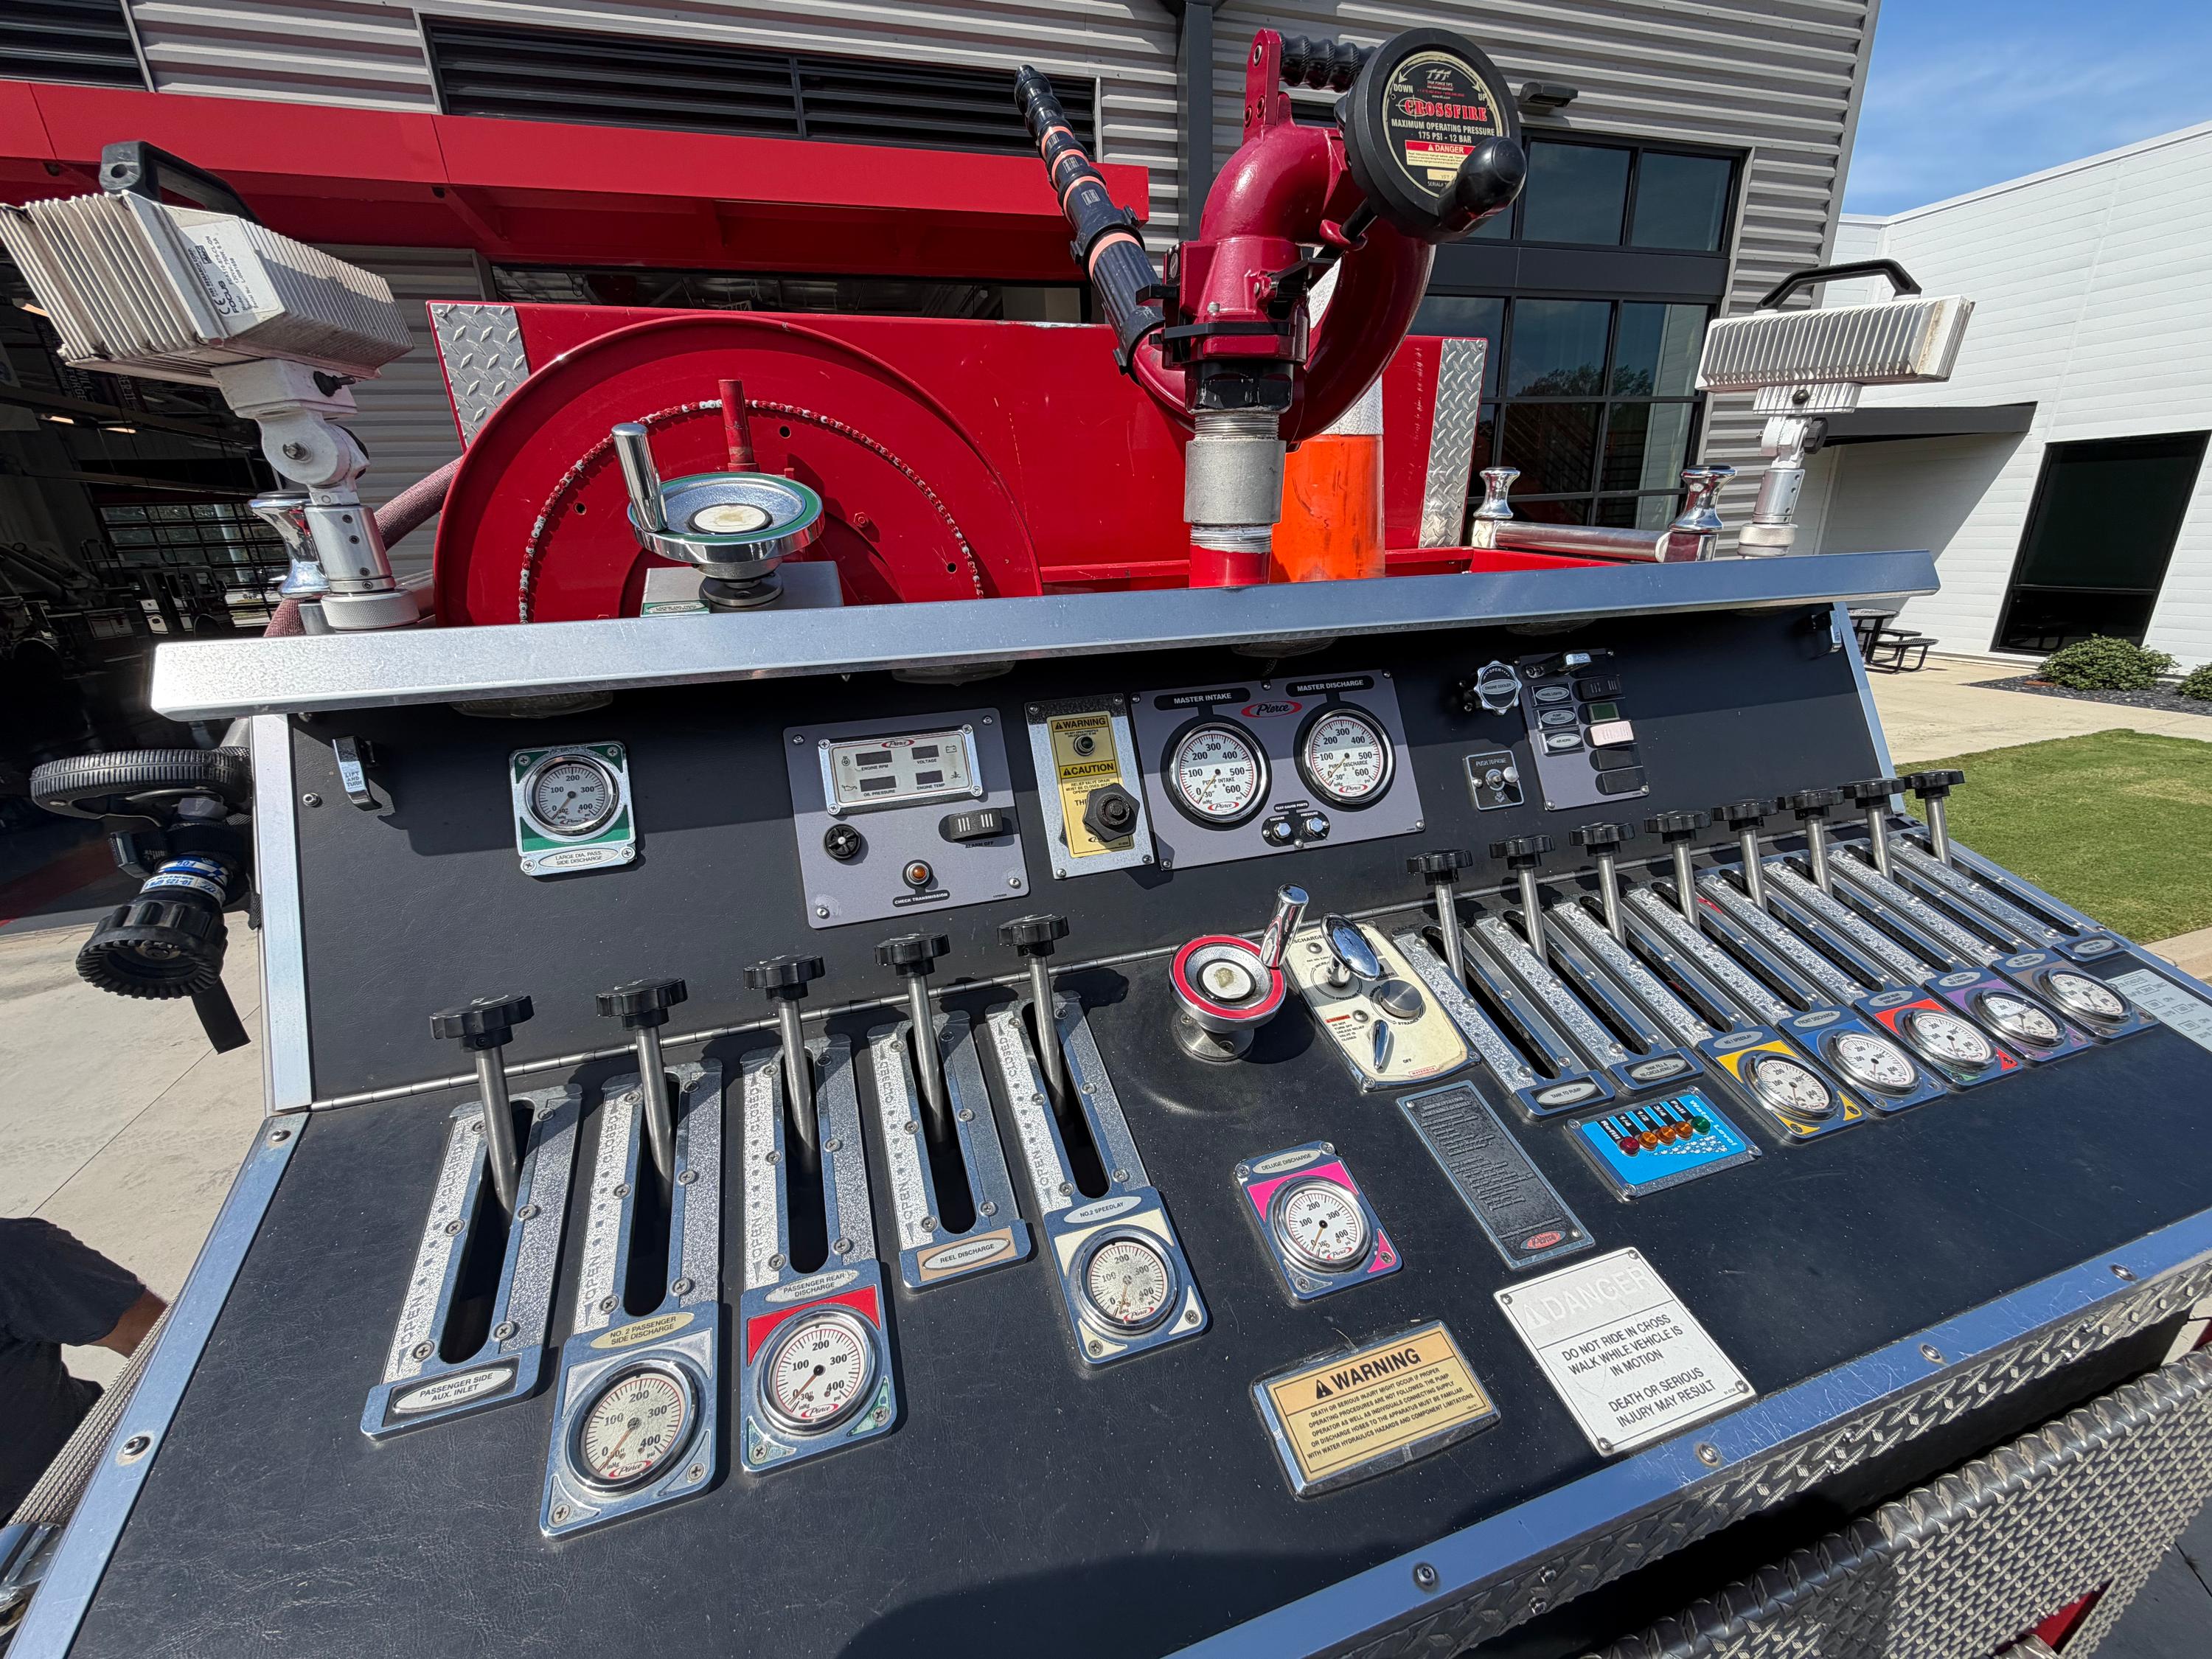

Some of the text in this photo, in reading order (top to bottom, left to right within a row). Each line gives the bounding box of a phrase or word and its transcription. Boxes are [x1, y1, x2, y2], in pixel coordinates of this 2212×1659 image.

[1394, 83, 1413, 93] DOWN
[1478, 93, 1486, 101] UP
[1405, 100, 1487, 122] CROSSFIRE
[1391, 119, 1495, 136] MAXIMUM OPERATING PRESSURE
[1418, 131, 1430, 140] 175
[1432, 133, 1442, 141] PSI
[1459, 135, 1472, 143] BAR
[1436, 145, 1464, 153] DANGER
[218, 281, 240, 313] FOCUS
[1297, 680, 1364, 692] MASTER DISCHARGE
[1174, 693, 1232, 704] MASTER INTAKE
[1256, 703, 1290, 716] Pierce
[1062, 717, 1106, 728] WARNING
[1335, 728, 1350, 736] 300
[1206, 742, 1222, 751] 300
[1323, 737, 1338, 745] 200
[1351, 736, 1366, 744] 400
[1192, 751, 1208, 761] 200
[1222, 751, 1237, 759] 400
[1320, 753, 1333, 761] 100
[1358, 751, 1372, 759] 500
[1071, 762, 1114, 774] CAUTION
[1343, 759, 1368, 768] DISCHARGE
[1188, 769, 1203, 778] 100
[1229, 767, 1245, 776] 500
[1354, 768, 1369, 776] 600
[1225, 785, 1241, 794] 600
[571, 855, 602, 863] DISCHARGE
[894, 892, 948, 905] CHECK TRANSMISSION
[1000, 1037, 1017, 1077] CLOSED
[1653, 1105, 1667, 1116] 3/4
[1670, 1100, 1687, 1114] Full
[1619, 1116, 1632, 1127] 1/4
[1637, 1110, 1649, 1121] 1/2
[1689, 1099, 1738, 1146] Water Level
[1600, 1120, 1621, 1140] Refill
[1034, 1150, 1049, 1186] OPEN
[1261, 1152, 1312, 1171] DELUGE DISCHARGE
[1079, 1201, 1124, 1218] NO.2 SPEEDLAY
[959, 1244, 995, 1258] DISCHARGE
[783, 1273, 845, 1293] PASSENGER REAR
[795, 1282, 835, 1297] DISCHARGE
[1543, 1266, 1655, 1321] DANGER
[632, 1316, 676, 1332] PASSENGER
[611, 1324, 674, 1345] SIDE DISCHARGE
[1562, 1314, 1671, 1361] DO NOT RIDE IN CROSS
[813, 1340, 830, 1351] 200
[1568, 1325, 1683, 1375] WALK WHILE VEHICLE IS
[792, 1360, 809, 1371] 100
[830, 1354, 848, 1365] 300
[1610, 1349, 1664, 1377] IN MOTION
[1329, 1347, 1422, 1391] WARNING
[420, 1373, 493, 1398] PASSENGER SIDE
[827, 1380, 844, 1391] 400
[1608, 1367, 1704, 1413] DEATH OR SERIOUS
[431, 1383, 479, 1402] AUX. INLET
[1311, 1408, 1329, 1417] DEATH
[1338, 1396, 1360, 1408] SERIOUS
[1360, 1390, 1379, 1400] INJURY
[1379, 1384, 1395, 1393] MIGHT
[1396, 1377, 1414, 1386] OCCUR
[1419, 1368, 1440, 1378] PROPER
[1309, 1413, 1339, 1428] OPERATING
[1339, 1399, 1374, 1417] PROCEDURES
[1374, 1396, 1384, 1404] ARE
[1436, 1373, 1449, 1382] PUMP
[1616, 1380, 1716, 1427] INJURY MAY RESULT
[1312, 1422, 1340, 1437] OPERATOR
[1349, 1415, 1363, 1423] WELL
[1371, 1399, 1403, 1415] INDIVIDUALS
[1404, 1388, 1436, 1403] CONNECTING
[1436, 1380, 1454, 1389] SUPPLY
[1320, 1429, 1352, 1444] DISCHARGE
[1352, 1422, 1370, 1432] HOSES
[1378, 1414, 1388, 1422] THE
[1389, 1403, 1418, 1419] APPARATUS
[1418, 1399, 1430, 1408] MUST
[1441, 1387, 1464, 1399] FAMILIAR
[1307, 1450, 1322, 1459] WITH
[1322, 1442, 1341, 1454] WATER
[1341, 1431, 1374, 1447] HYDRAULICS
[1374, 1421, 1399, 1434] HAZARDS
[1400, 1416, 1411, 1425] AND
[1411, 1405, 1443, 1420] COMPONENT
